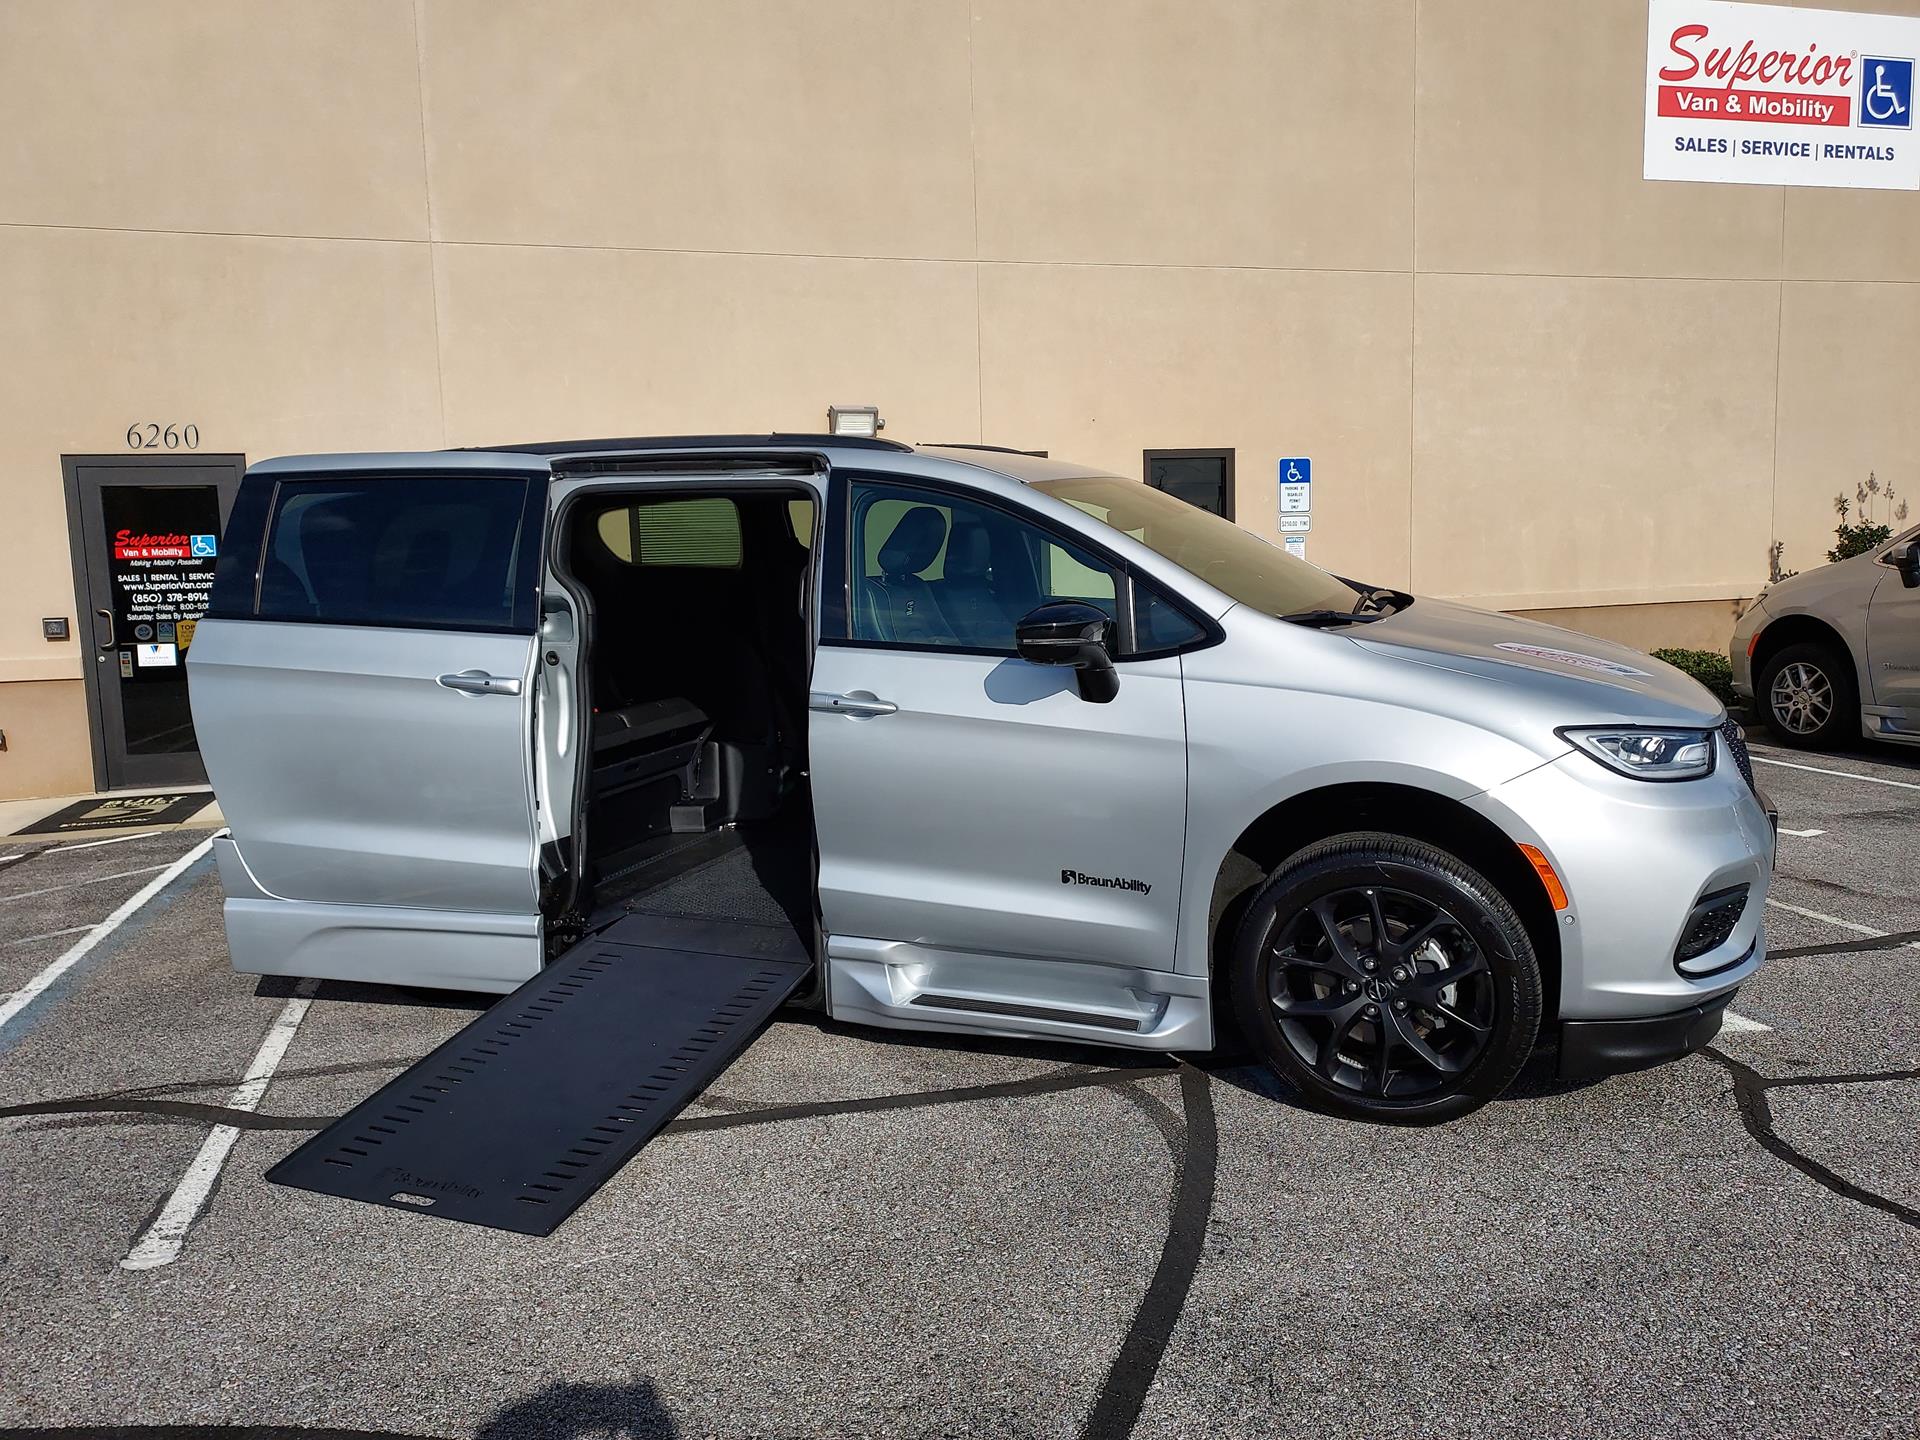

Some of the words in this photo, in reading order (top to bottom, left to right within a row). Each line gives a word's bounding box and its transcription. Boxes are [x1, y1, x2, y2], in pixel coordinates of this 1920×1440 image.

[1658, 24, 1853, 91] Superior
[1676, 91, 1718, 113] Van
[1725, 95, 1742, 113] &
[1749, 96, 1834, 123] Mobility
[1674, 136, 1728, 153] SALES
[1741, 140, 1811, 158] SERVICE
[1823, 144, 1895, 161] RENTALS
[126, 423, 200, 449] 6260
[114, 529, 189, 548] Superior
[122, 549, 139, 557] Van
[151, 548, 183, 558] Mobility
[117, 574, 141, 582] SALES
[151, 573, 178, 581] RENTAL
[132, 593, 162, 604] (850)
[166, 592, 209, 602] 378-8914
[155, 612, 172, 620] Sales
[1077, 873, 1152, 895] BraunAbility
